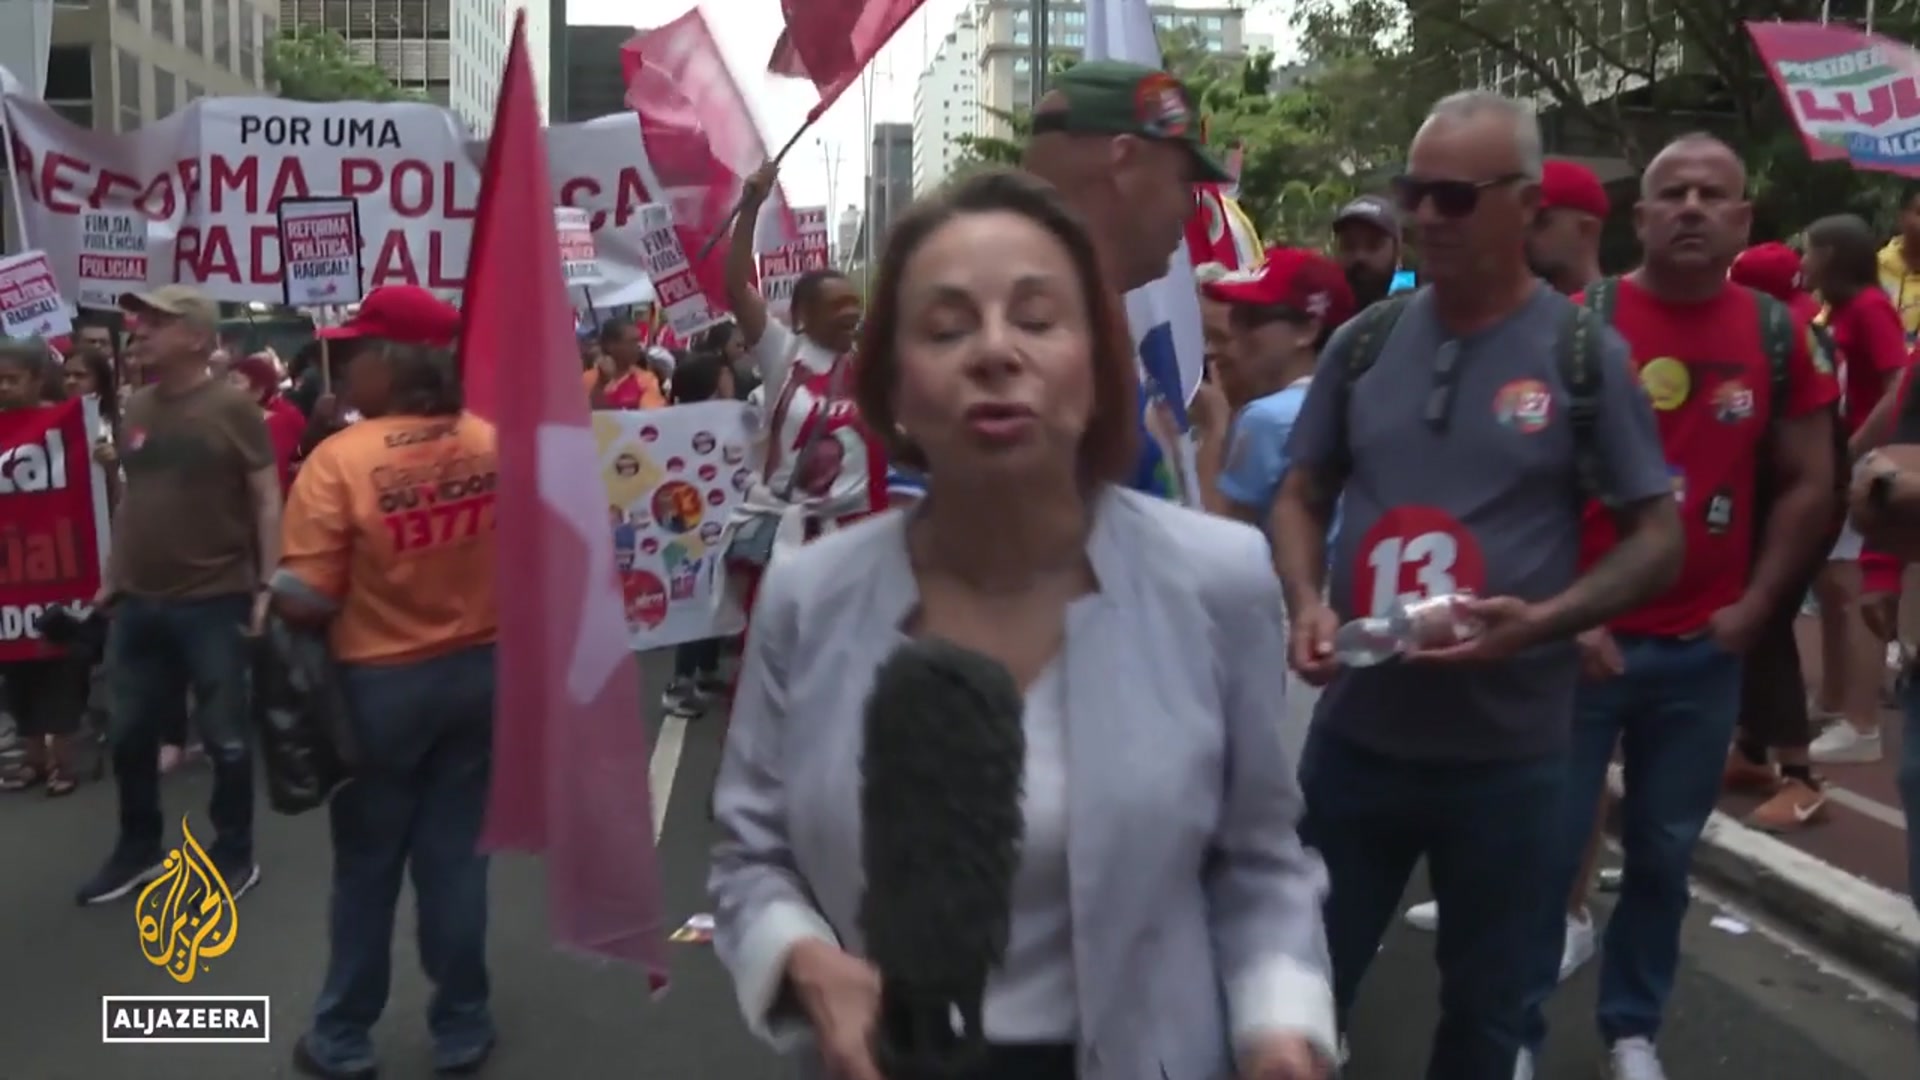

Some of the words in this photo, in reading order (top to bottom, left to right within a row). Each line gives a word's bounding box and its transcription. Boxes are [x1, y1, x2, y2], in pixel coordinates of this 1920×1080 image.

[241, 115, 311, 144] POR
[323, 118, 401, 148] UMA
[85, 215, 109, 232] FIM
[113, 216, 132, 232] DA
[287, 216, 348, 239] REFORMA
[174, 225, 466, 288] RADAL
[642, 228, 675, 259] FIM
[82, 257, 146, 279] POLICIAL
[293, 260, 349, 280] RADICAL!
[0, 518, 78, 584] ial
[1369, 531, 1457, 618] 13
